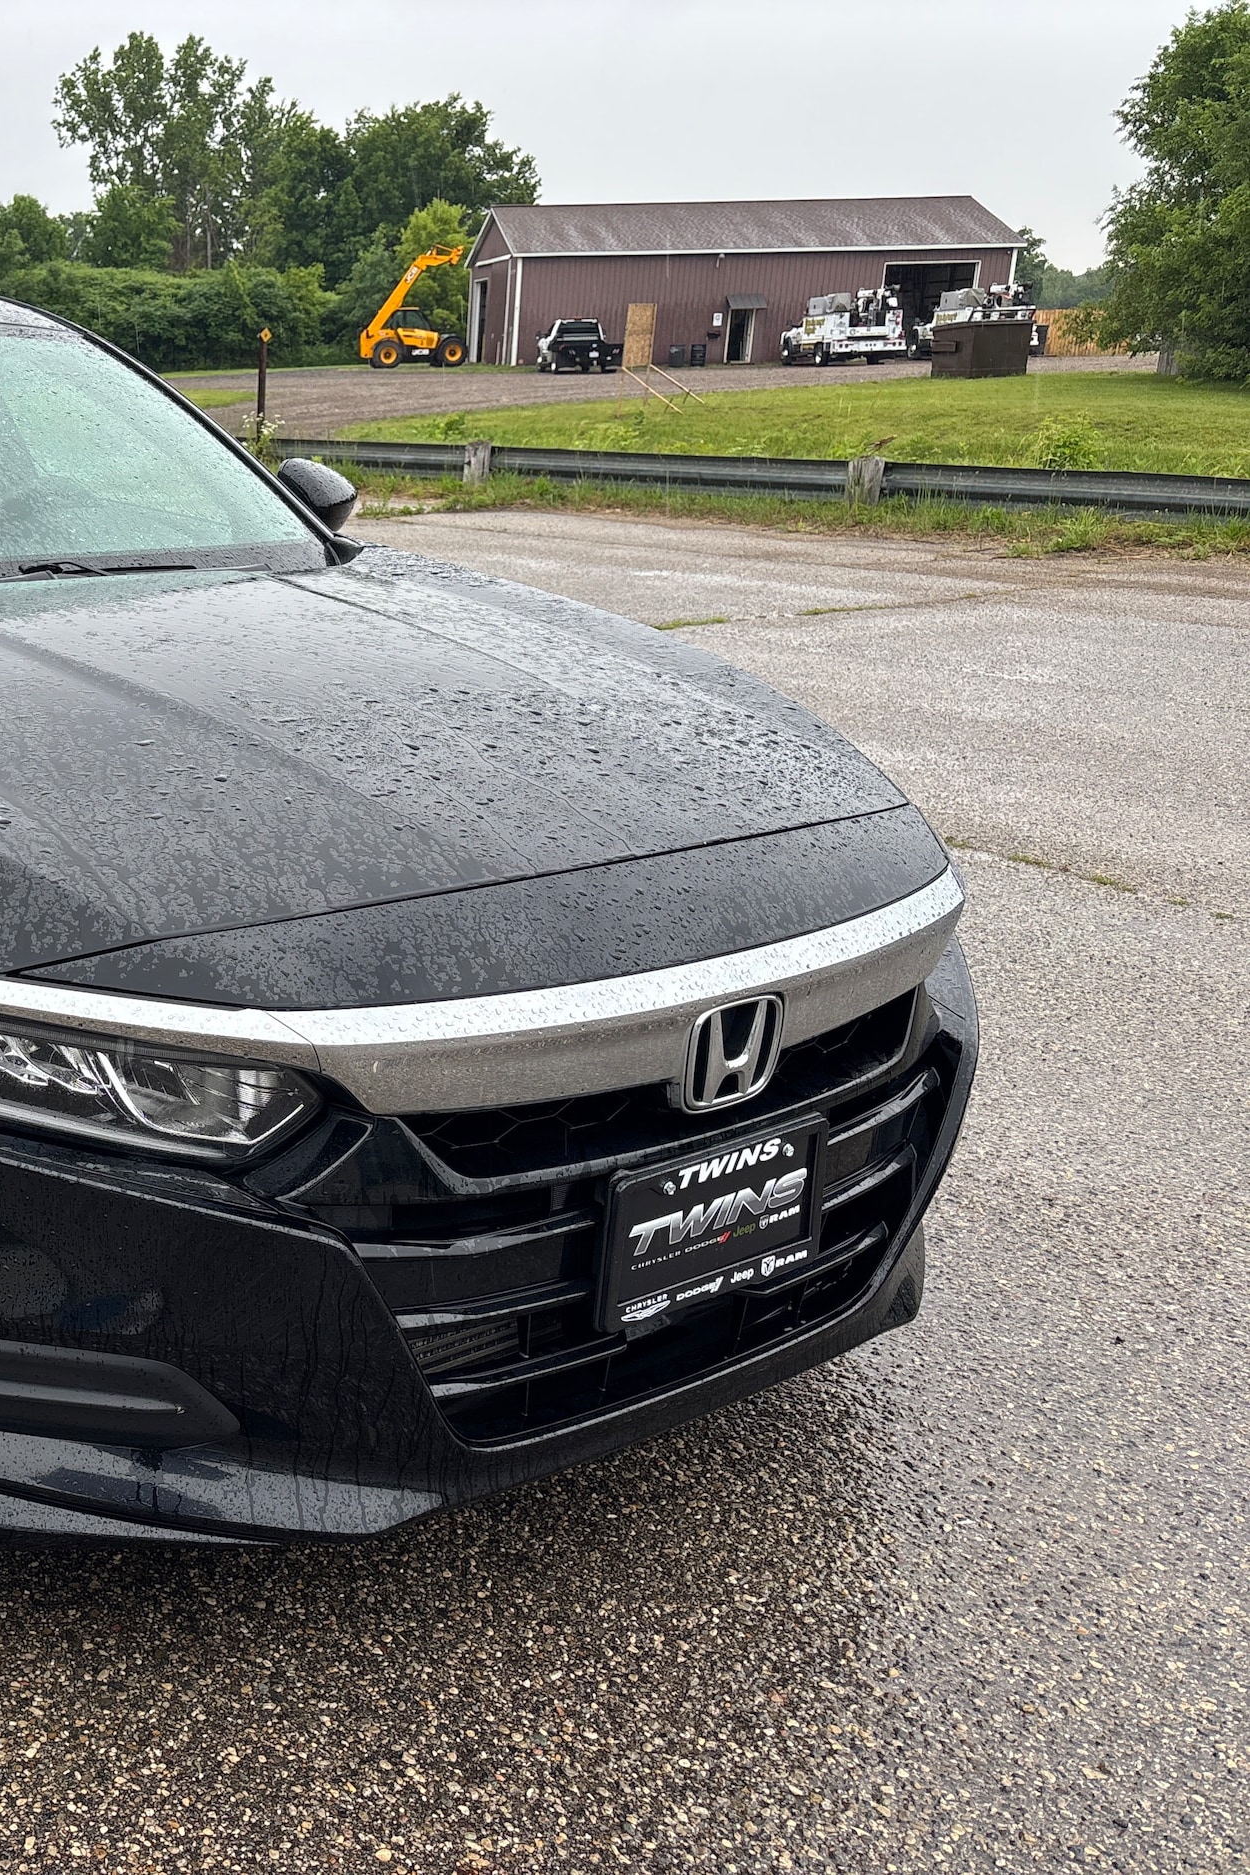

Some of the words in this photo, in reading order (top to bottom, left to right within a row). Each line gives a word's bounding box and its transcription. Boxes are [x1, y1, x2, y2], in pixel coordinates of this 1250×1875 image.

[405, 267, 419, 283] JCB
[679, 1138, 781, 1189] TWINS
[629, 1168, 807, 1256] TWINS
[631, 1251, 681, 1270] CHRYSLER
[685, 1236, 726, 1253] DODGE
[733, 1222, 756, 1238] Jeep
[769, 1205, 800, 1223] RAM
[626, 1294, 668, 1313] CHRYSLER
[676, 1282, 717, 1301] DODGE
[731, 1268, 754, 1283] Jeep
[776, 1250, 808, 1267] RAM
